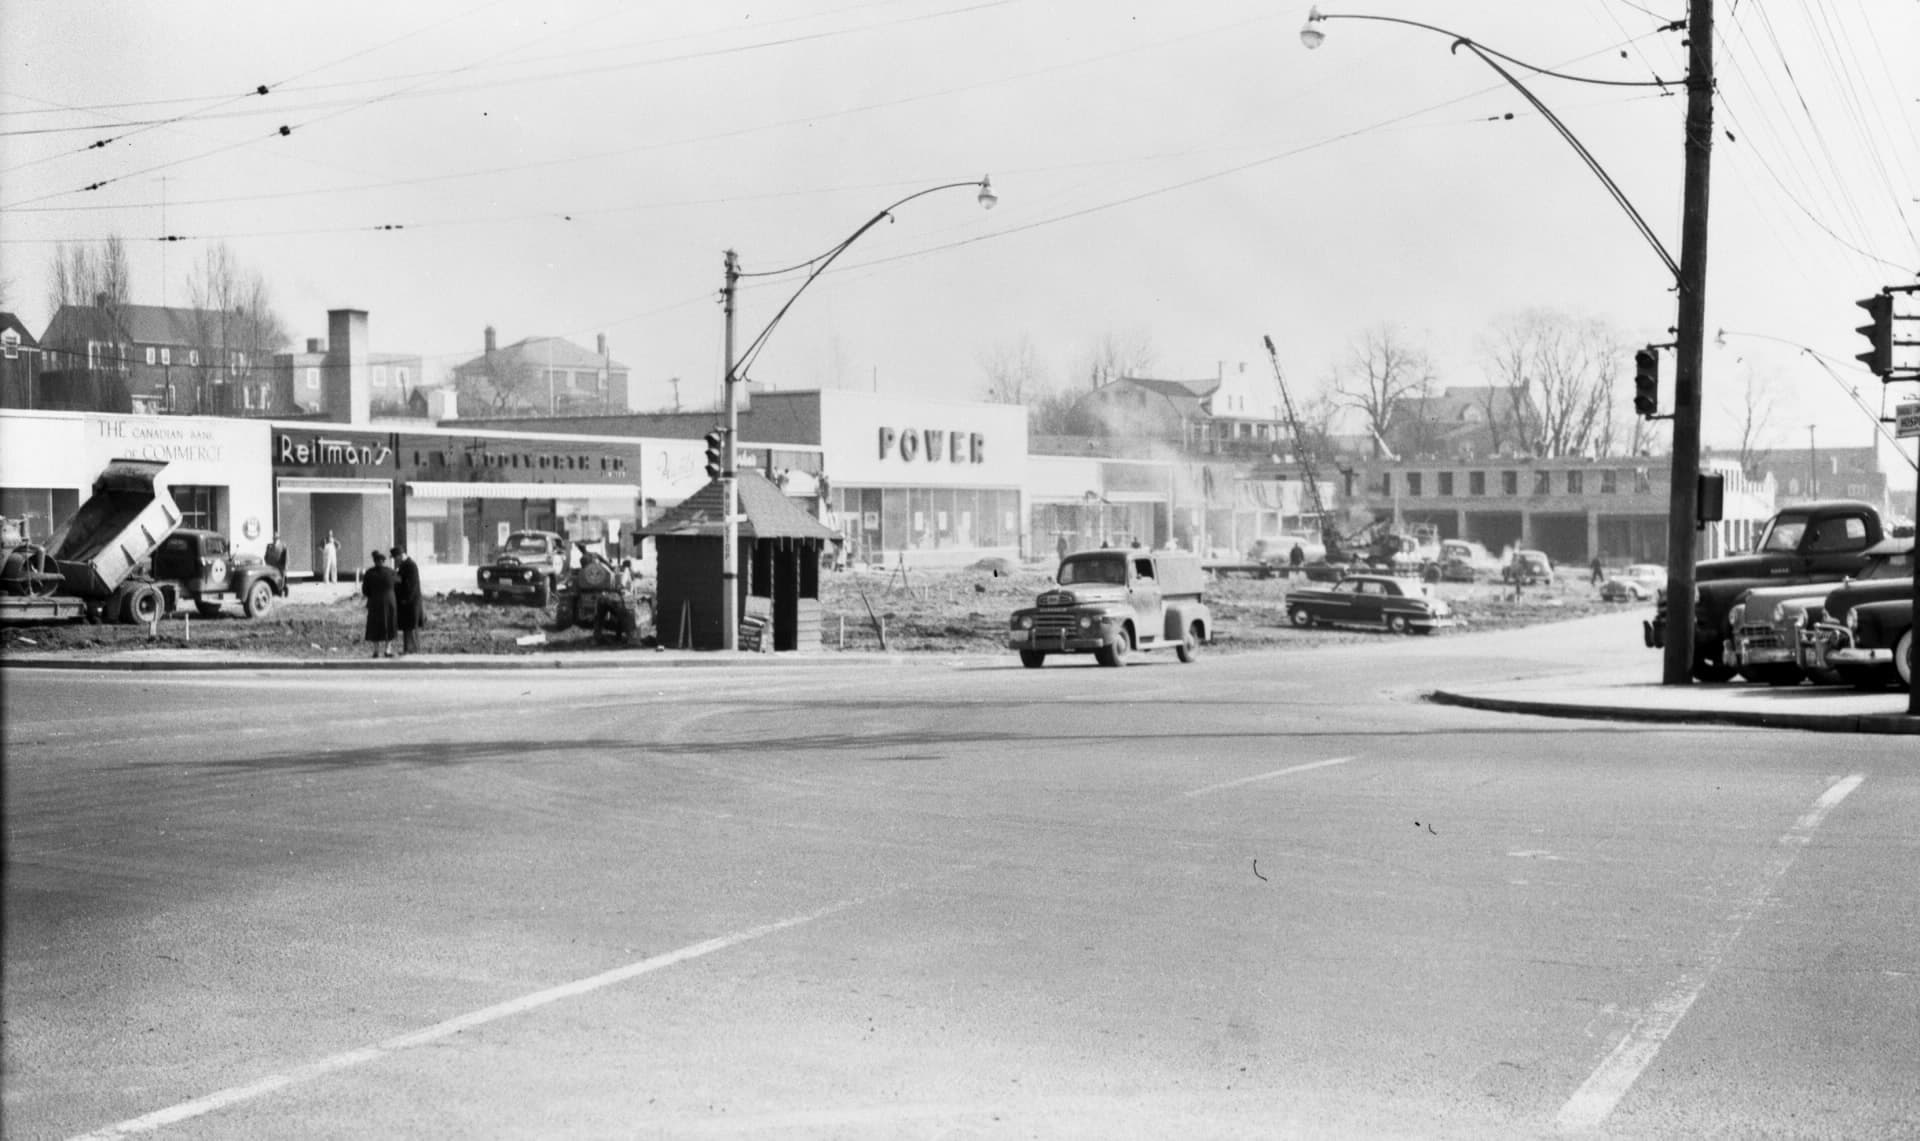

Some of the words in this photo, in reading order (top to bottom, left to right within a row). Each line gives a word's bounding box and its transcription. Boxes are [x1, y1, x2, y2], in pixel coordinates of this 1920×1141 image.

[97, 419, 126, 438] THE
[132, 427, 183, 440] CANADIAN
[190, 430, 214, 440] BANK
[142, 444, 222, 462] COMMERCE
[281, 433, 392, 466] Reitman's
[878, 427, 984, 464] POWER
